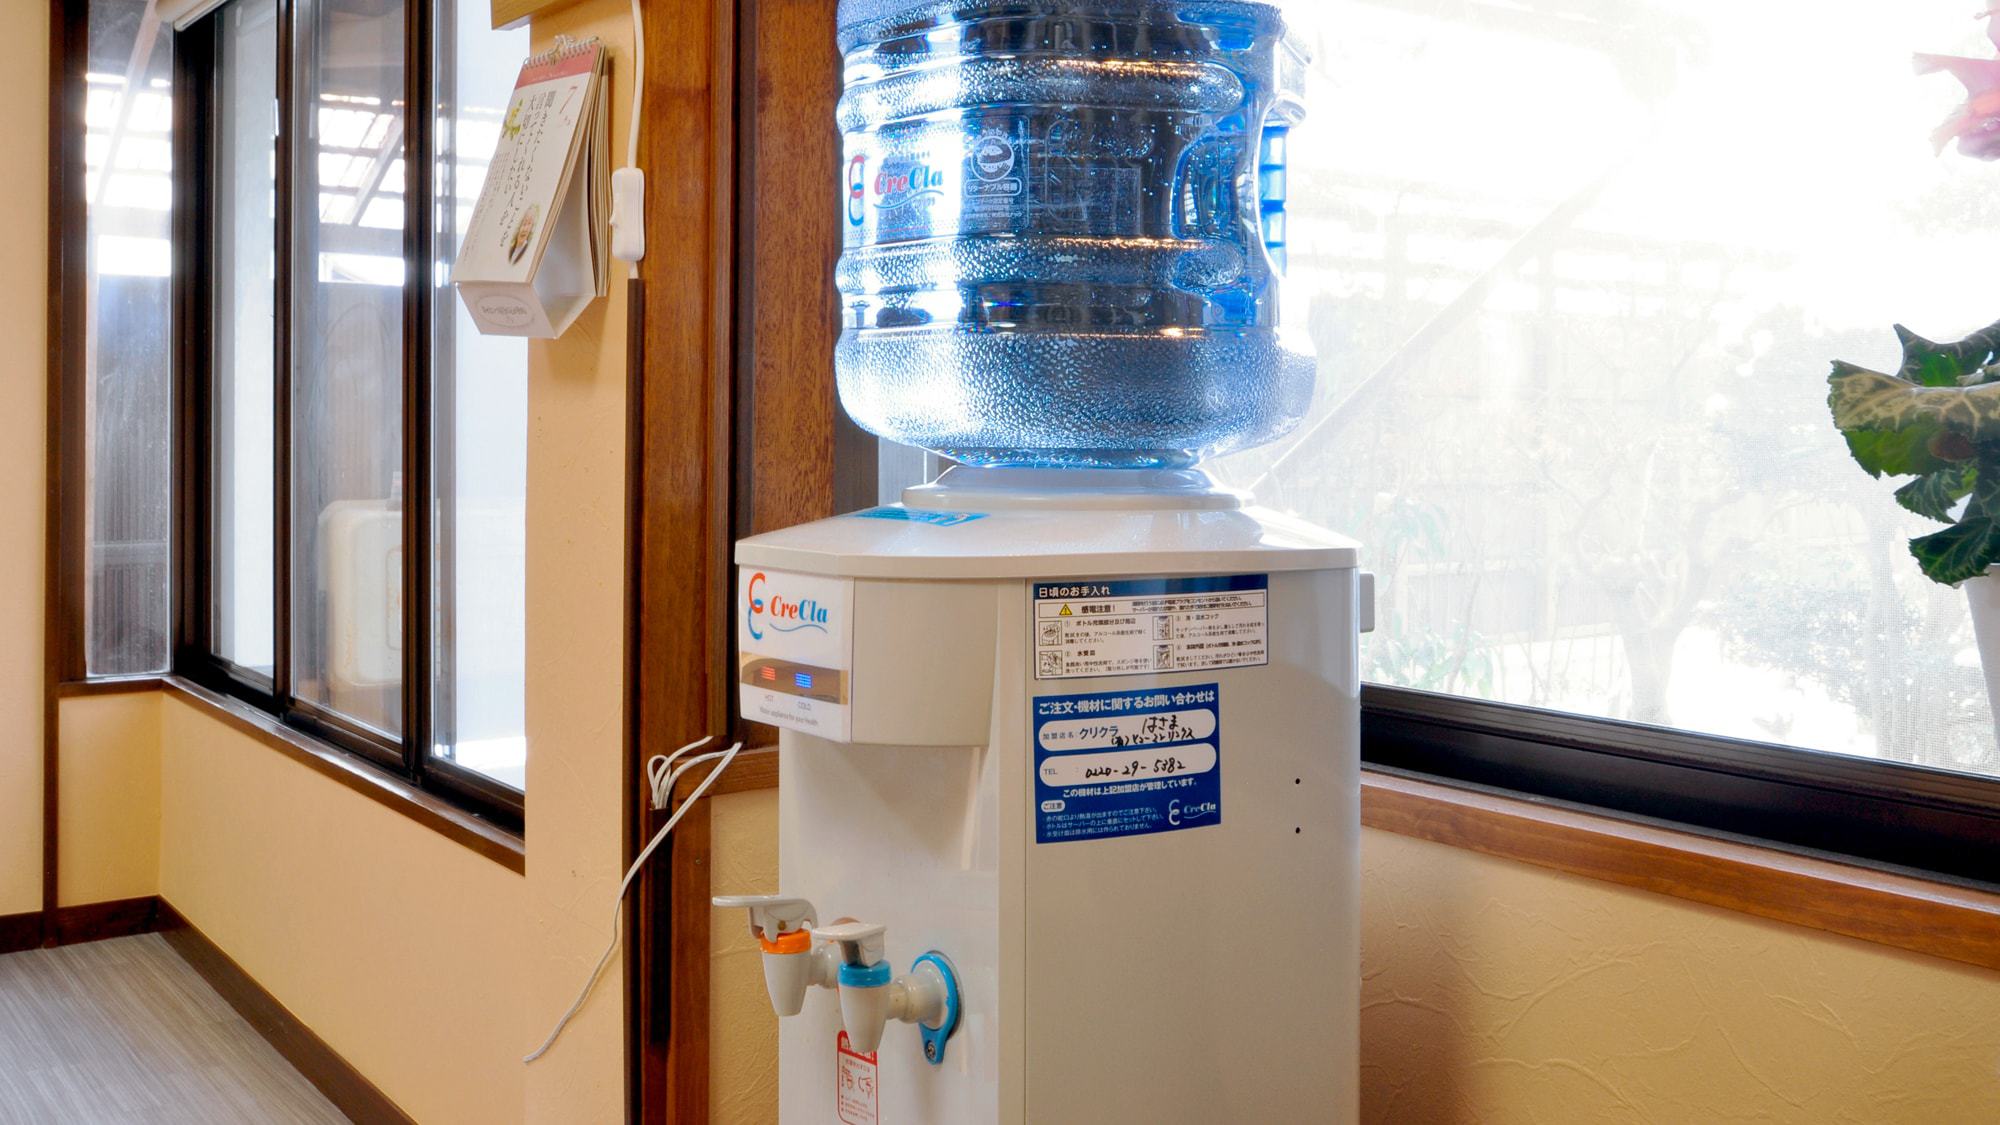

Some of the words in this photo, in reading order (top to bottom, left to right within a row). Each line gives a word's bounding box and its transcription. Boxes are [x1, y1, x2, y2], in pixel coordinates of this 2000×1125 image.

[559, 85, 578, 114] 7
[874, 166, 943, 195] CreCla
[1039, 586, 1111, 598] 日頃のお手入れ
[770, 595, 828, 623] CreCla
[1039, 690, 1215, 715] ご注文・機材に関するお問い合わせは
[1079, 725, 1119, 738] クリクラ
[1142, 715, 1179, 734] はさま
[1044, 767, 1057, 775] TEL
